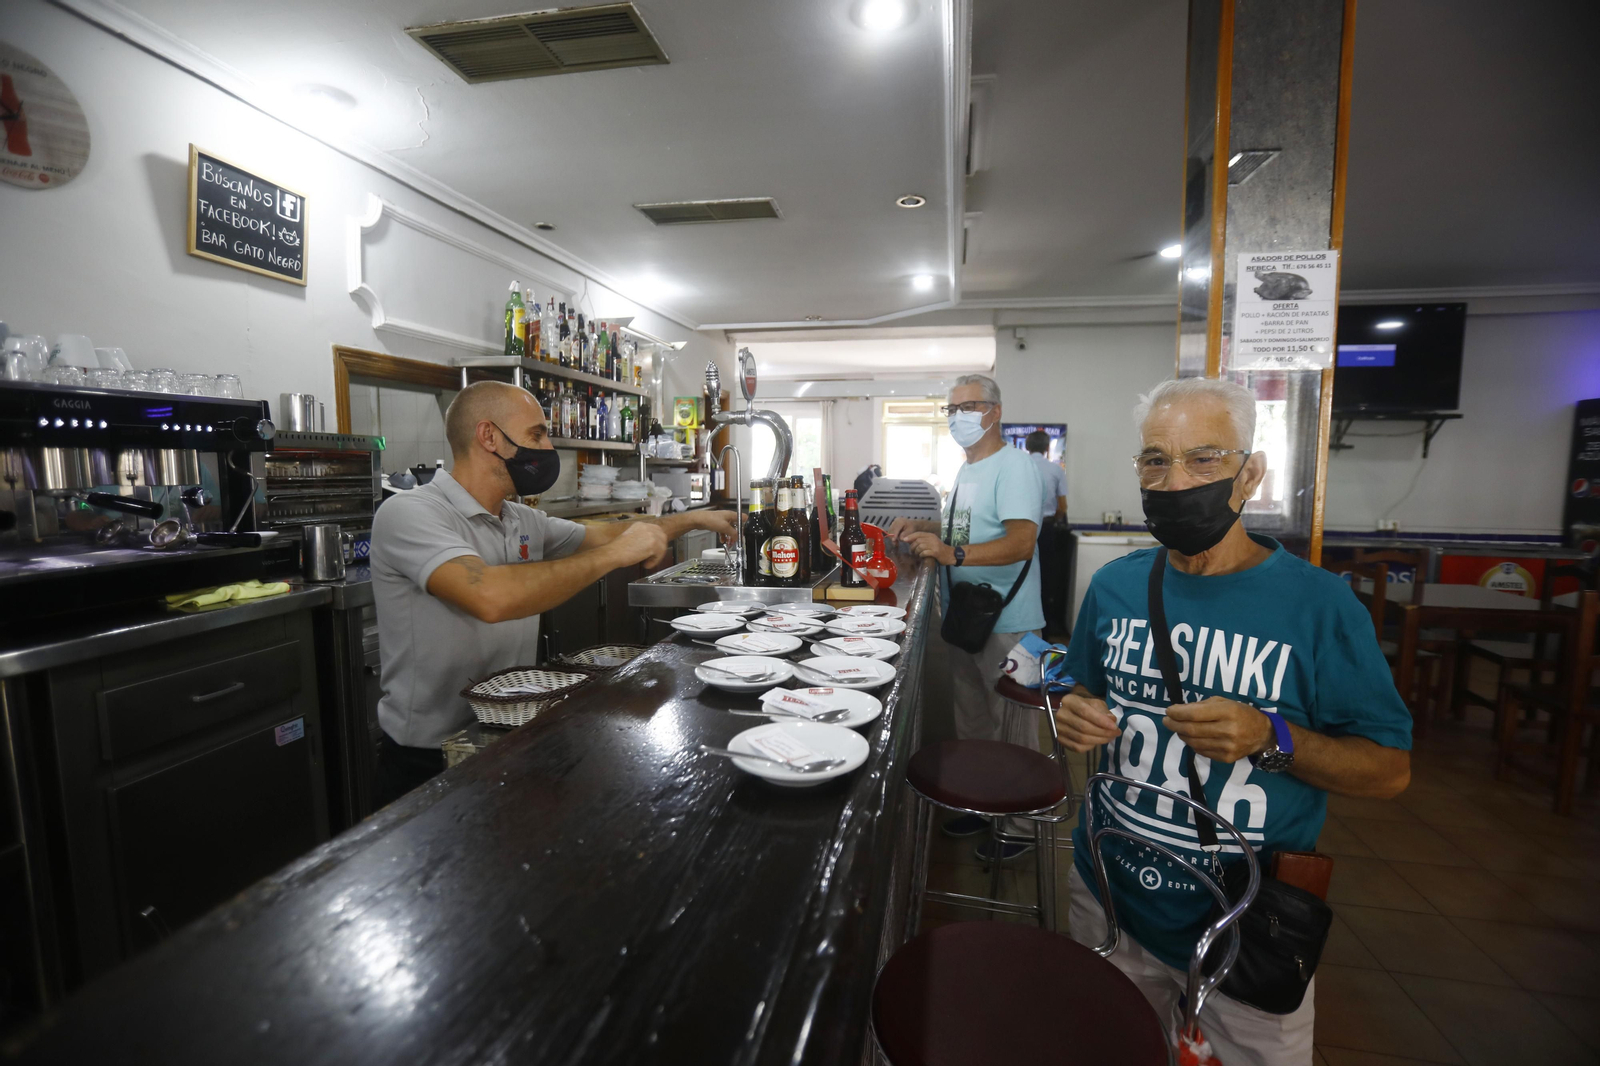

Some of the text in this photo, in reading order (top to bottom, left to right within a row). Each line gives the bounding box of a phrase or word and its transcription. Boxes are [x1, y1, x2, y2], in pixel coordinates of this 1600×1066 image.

[201, 162, 273, 207] BÚSCANOS
[230, 195, 247, 210] EN
[199, 198, 277, 241] FACEBOOK!
[233, 240, 265, 260] GATO
[53, 399, 91, 410] GAGGIA
[1104, 618, 1293, 701] HELSINKI
[1167, 880, 1196, 891] EDTN
